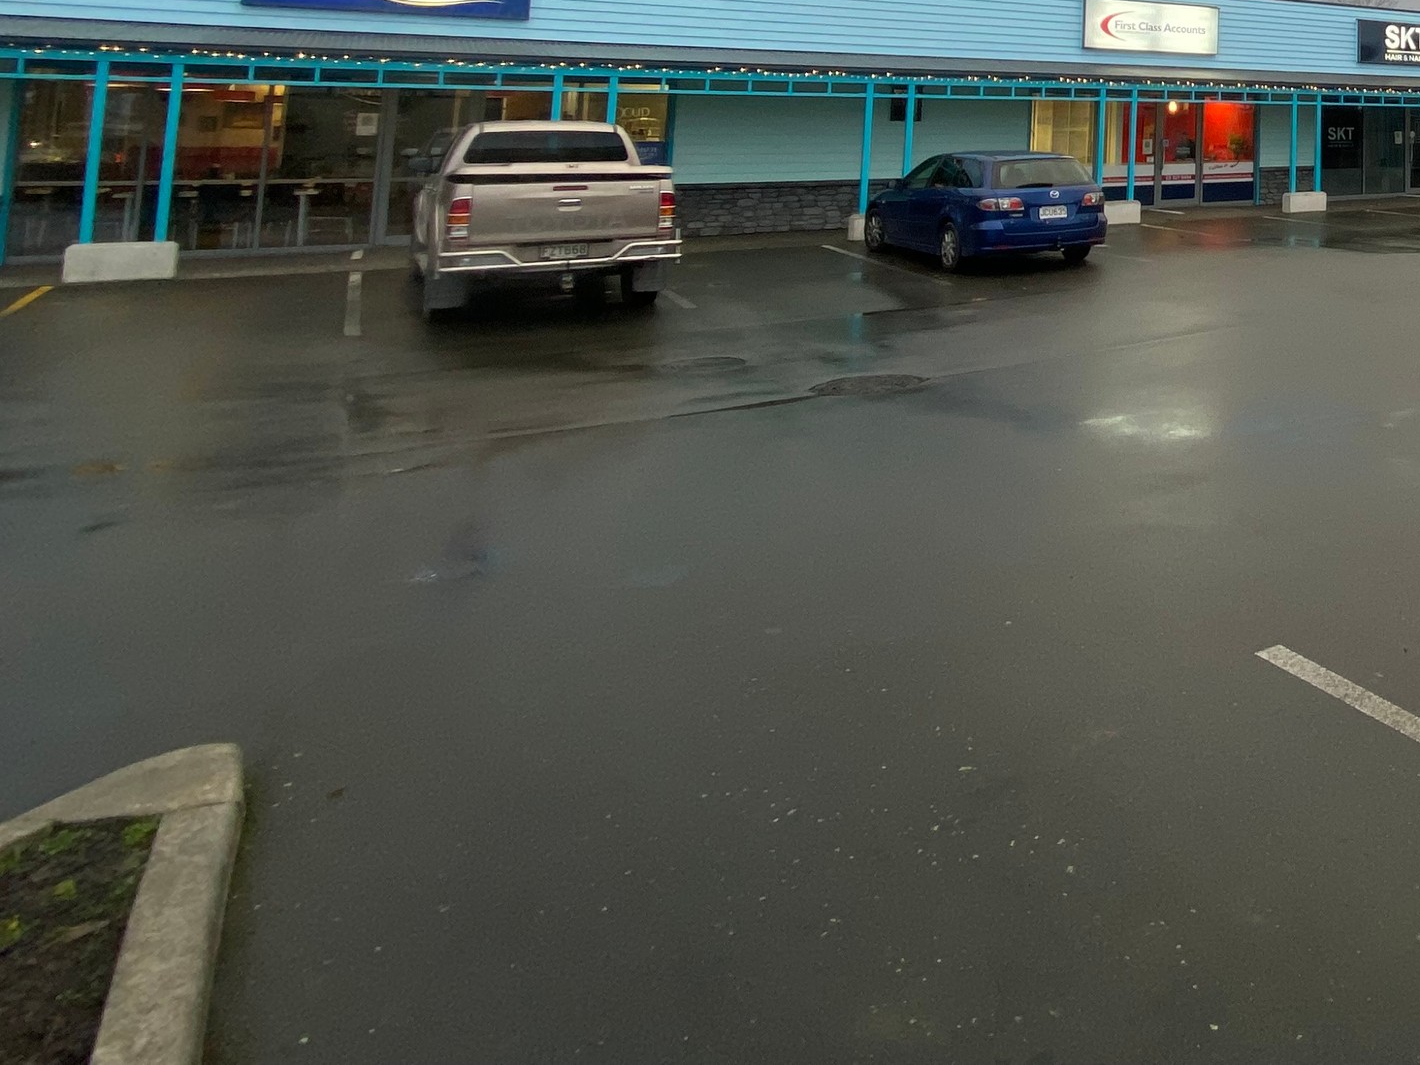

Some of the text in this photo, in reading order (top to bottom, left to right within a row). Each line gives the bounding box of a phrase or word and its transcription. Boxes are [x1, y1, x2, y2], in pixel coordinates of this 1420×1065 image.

[1114, 20, 1136, 31] First
[1138, 21, 1161, 32] Class
[1163, 23, 1206, 35] Accounts
[1384, 53, 1403, 61] HAIR
[1327, 127, 1355, 140] SKT
